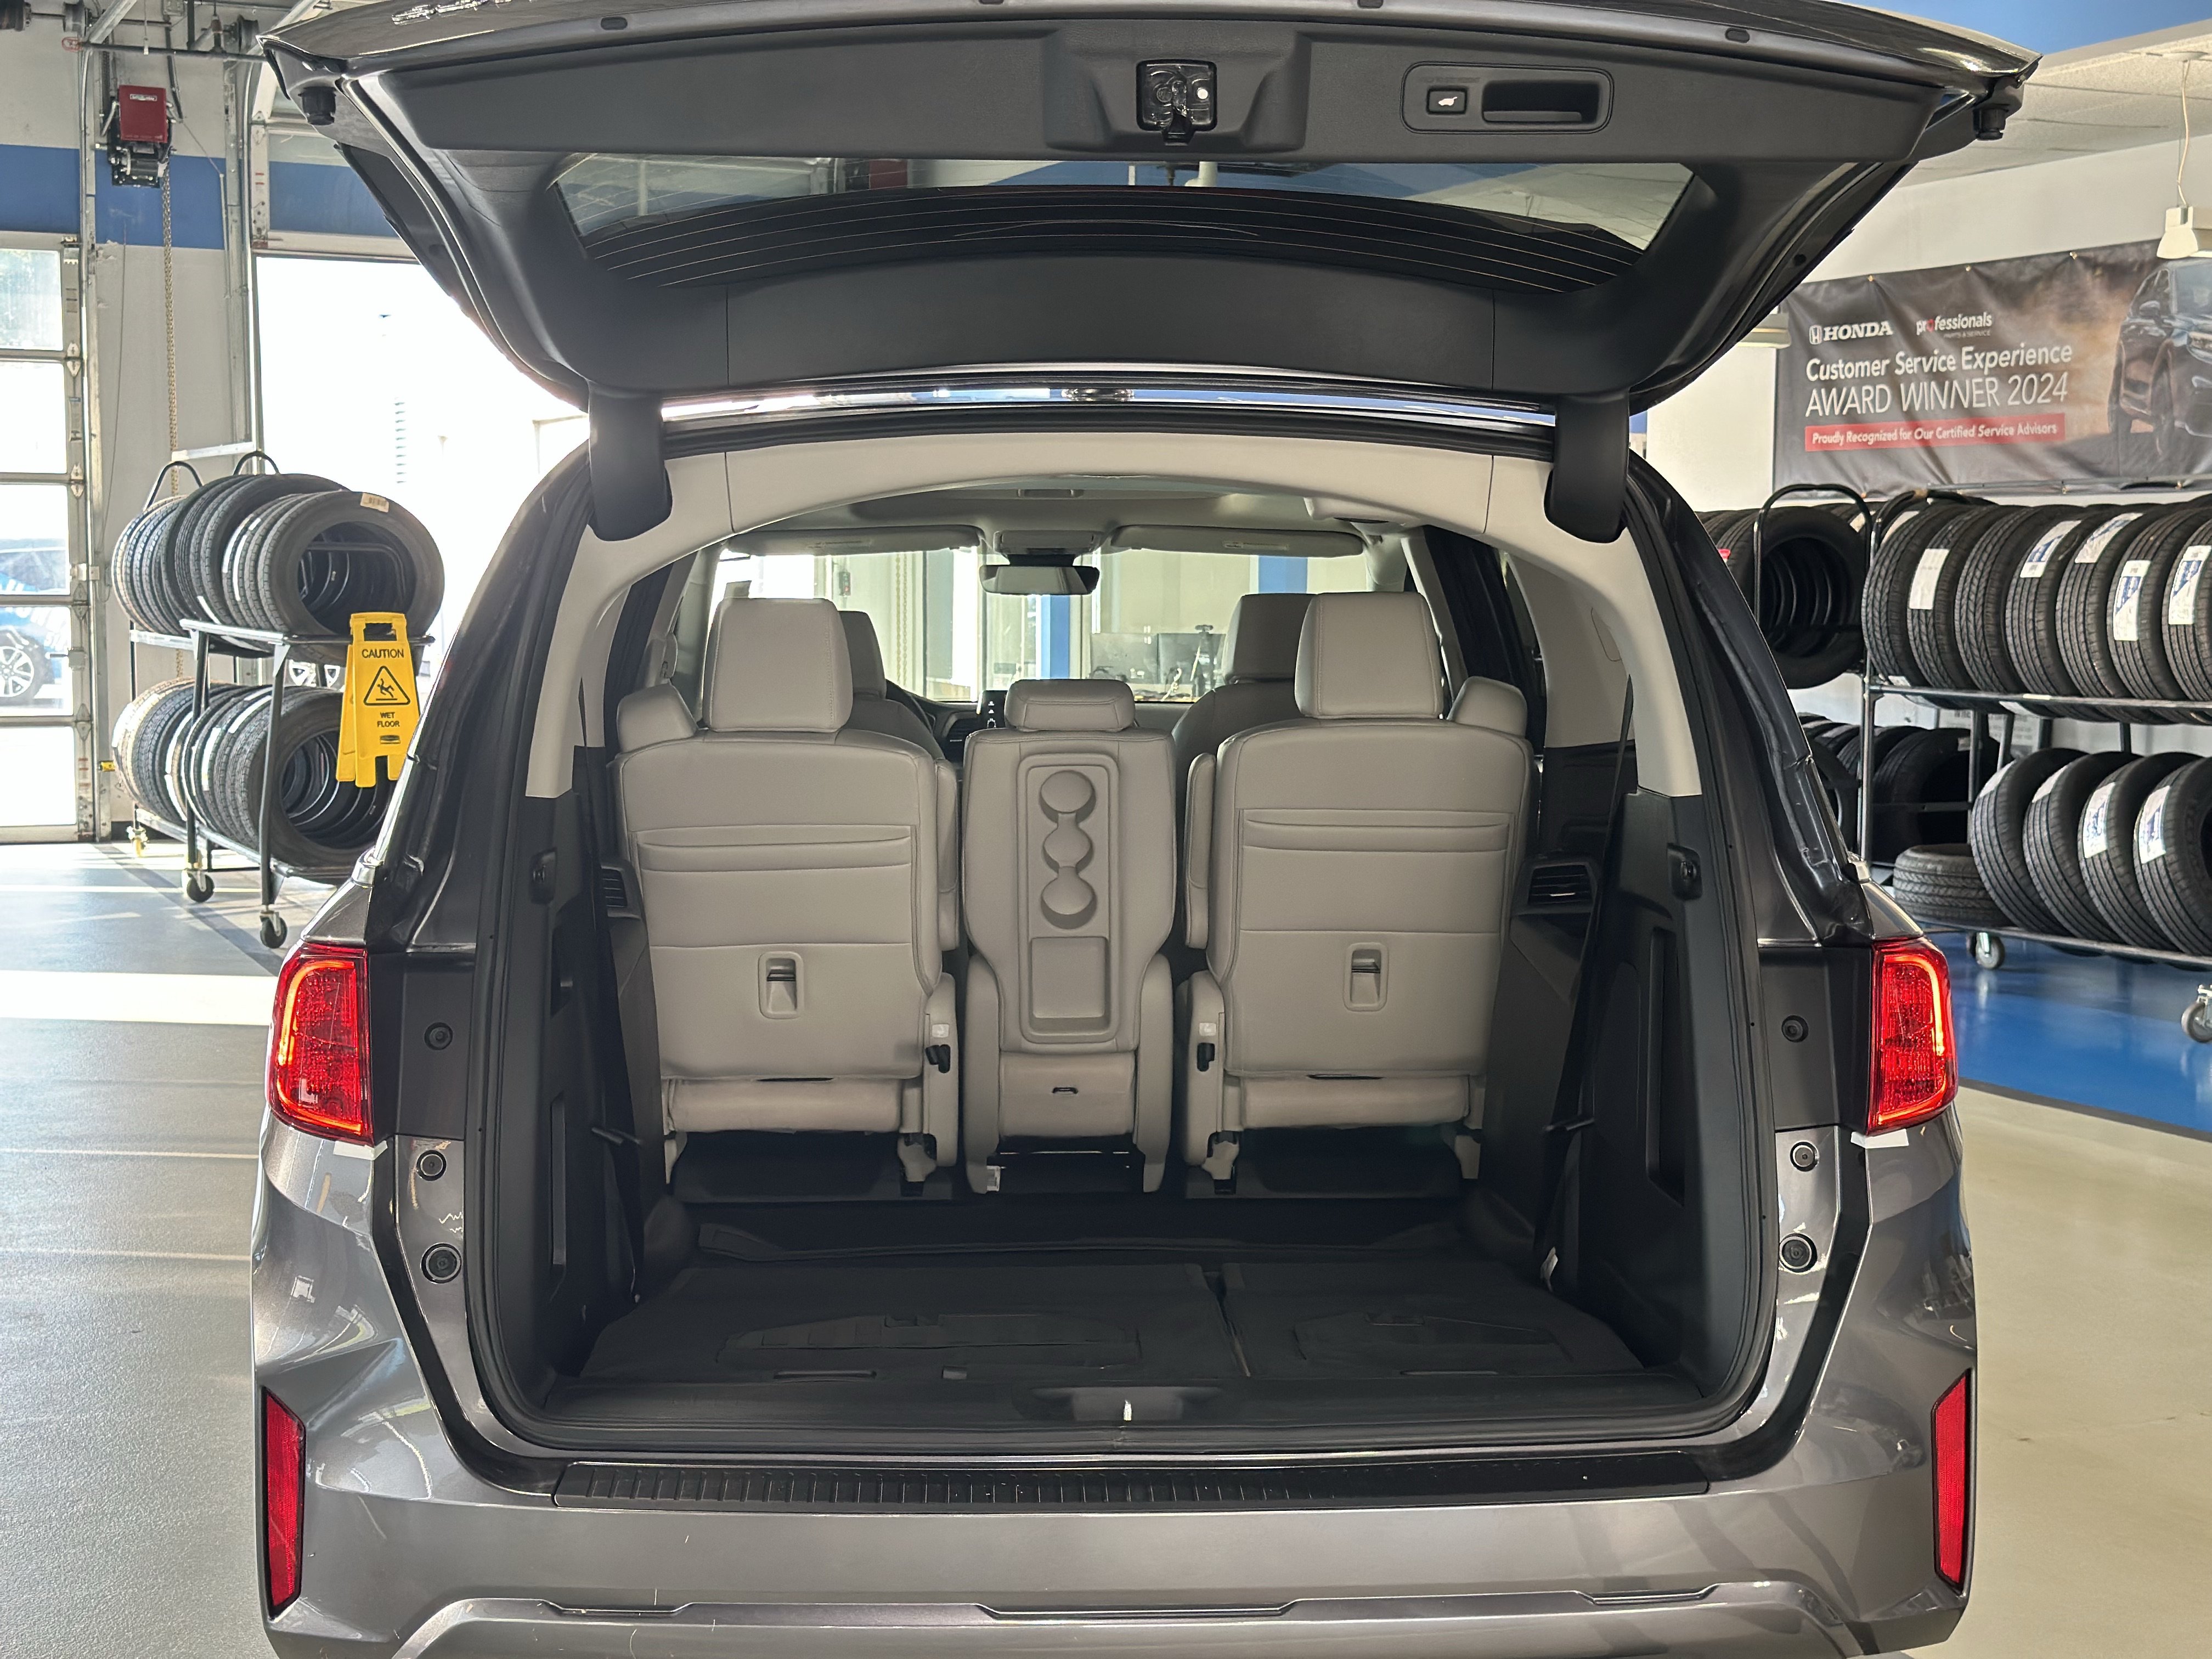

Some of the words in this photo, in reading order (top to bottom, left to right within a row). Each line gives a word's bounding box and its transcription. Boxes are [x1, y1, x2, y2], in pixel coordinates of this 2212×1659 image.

[1823, 320, 1893, 341] HONDA
[1916, 312, 1992, 335] professionals
[1806, 358, 1891, 381] Customer
[1894, 349, 1956, 375] Service
[1961, 342, 2073, 375] Experience
[1805, 384, 1892, 417] AWARD
[1900, 377, 2000, 412] WINNER
[2007, 371, 2068, 406] 2024
[1812, 431, 1844, 445] Proudly
[1846, 428, 1898, 445] Recognized
[1899, 428, 1912, 440] for
[1914, 427, 1934, 439] Our
[1936, 425, 1976, 439] Certified
[1977, 424, 2014, 437] Service
[2017, 421, 2057, 435] Advisors
[362, 648, 404, 658] CAUTION
